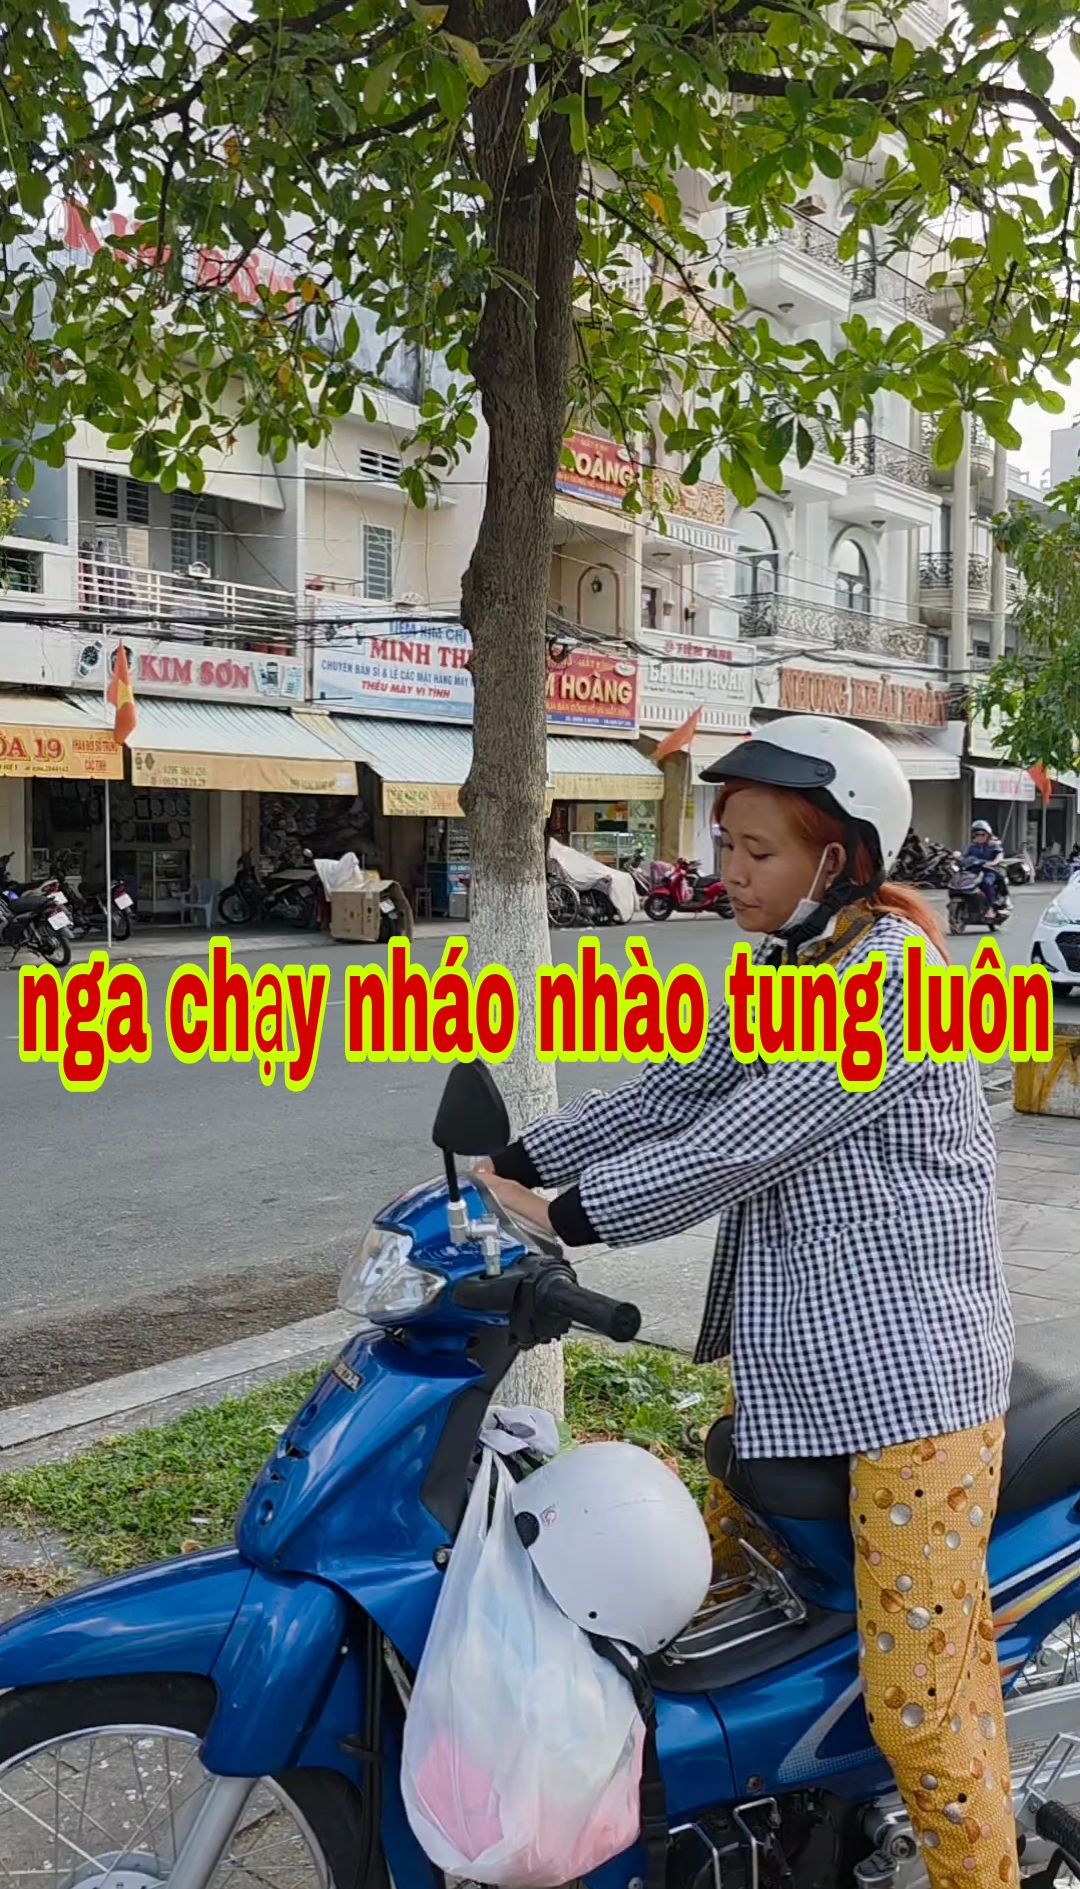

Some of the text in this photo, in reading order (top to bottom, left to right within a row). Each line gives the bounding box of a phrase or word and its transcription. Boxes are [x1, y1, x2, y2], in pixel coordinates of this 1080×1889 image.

[560, 450, 635, 487] OÀNG
[370, 637, 431, 666] MINH
[139, 653, 251, 689] KIM SƠN
[361, 679, 388, 692] THÊU
[561, 669, 633, 705] HOÀNG
[779, 667, 849, 715] NHUNG
[33, 738, 63, 760] 19
